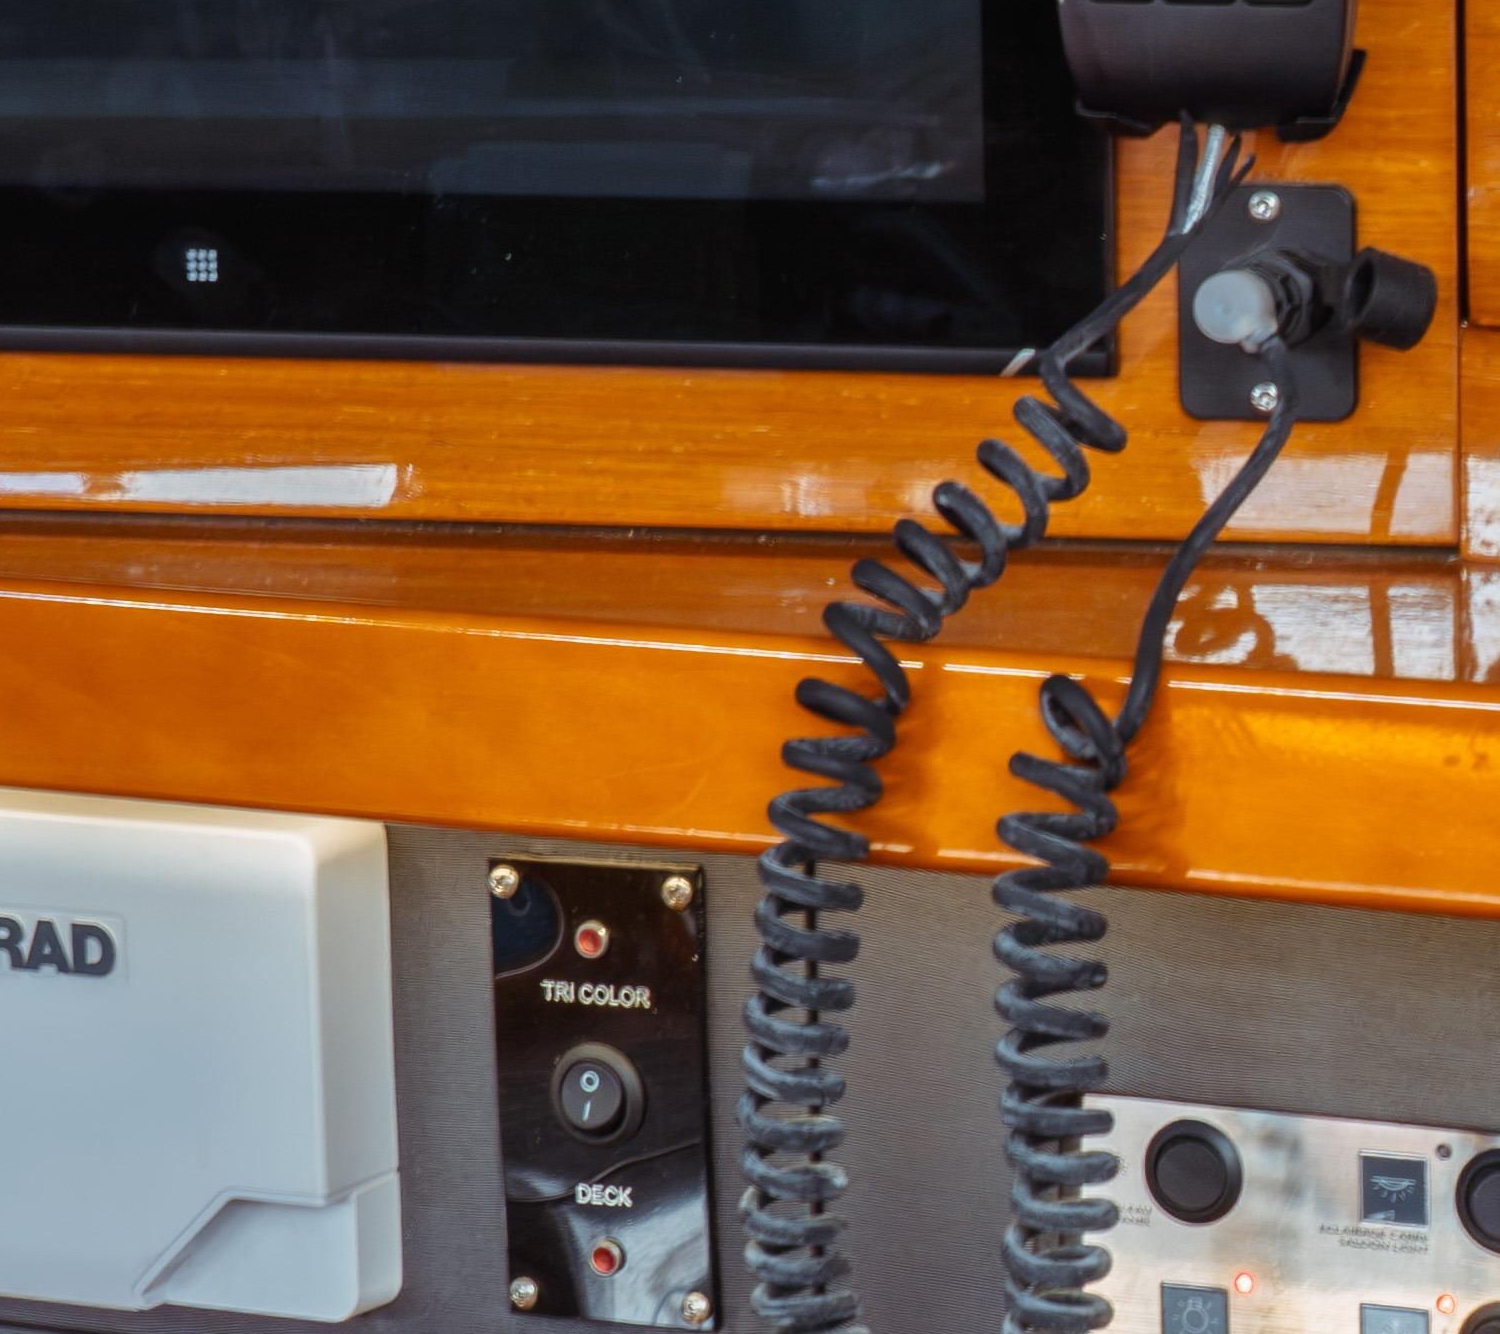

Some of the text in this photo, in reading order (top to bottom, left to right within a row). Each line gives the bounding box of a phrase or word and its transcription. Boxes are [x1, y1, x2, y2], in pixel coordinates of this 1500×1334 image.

[540, 979, 652, 1010] TRI COLOR
[574, 1183, 633, 1209] DECK
